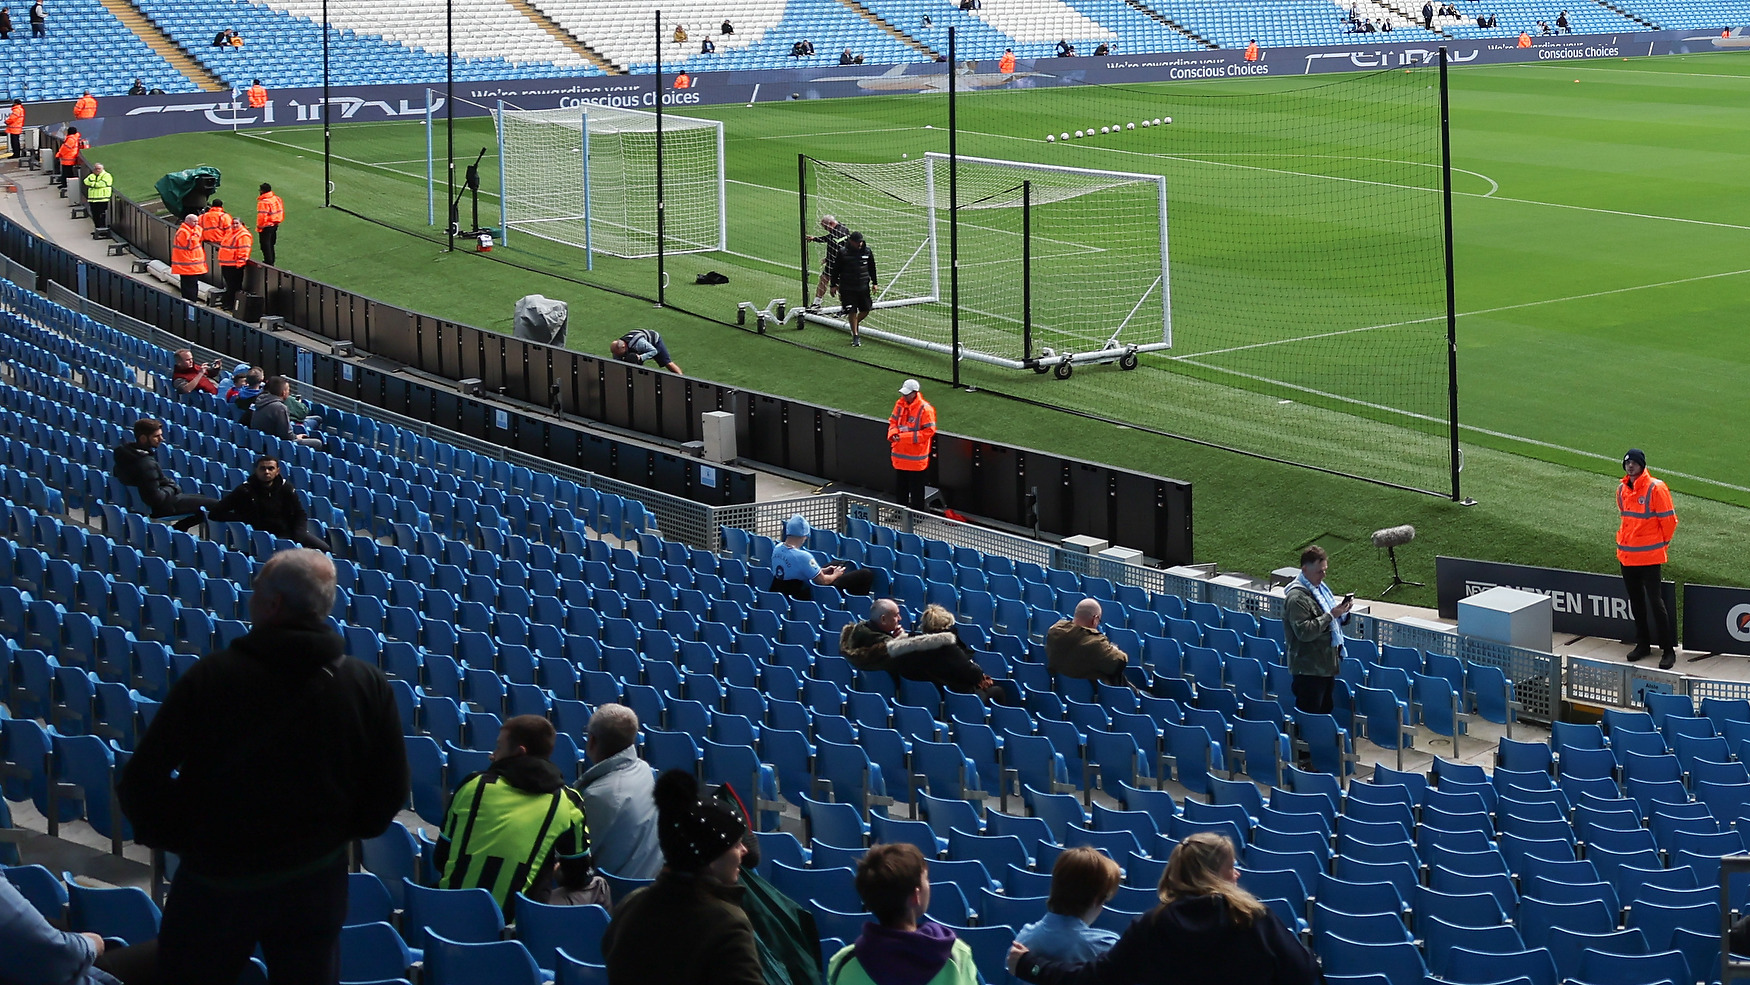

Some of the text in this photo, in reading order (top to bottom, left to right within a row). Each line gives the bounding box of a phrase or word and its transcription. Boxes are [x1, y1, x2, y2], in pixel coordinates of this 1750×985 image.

[1538, 45, 1619, 60] Conscious Choices
[1169, 61, 1269, 80] Conscious Choices
[559, 93, 639, 110] Conscious
[1587, 594, 1637, 621] TIR
[1645, 682, 1659, 691] Aisle
